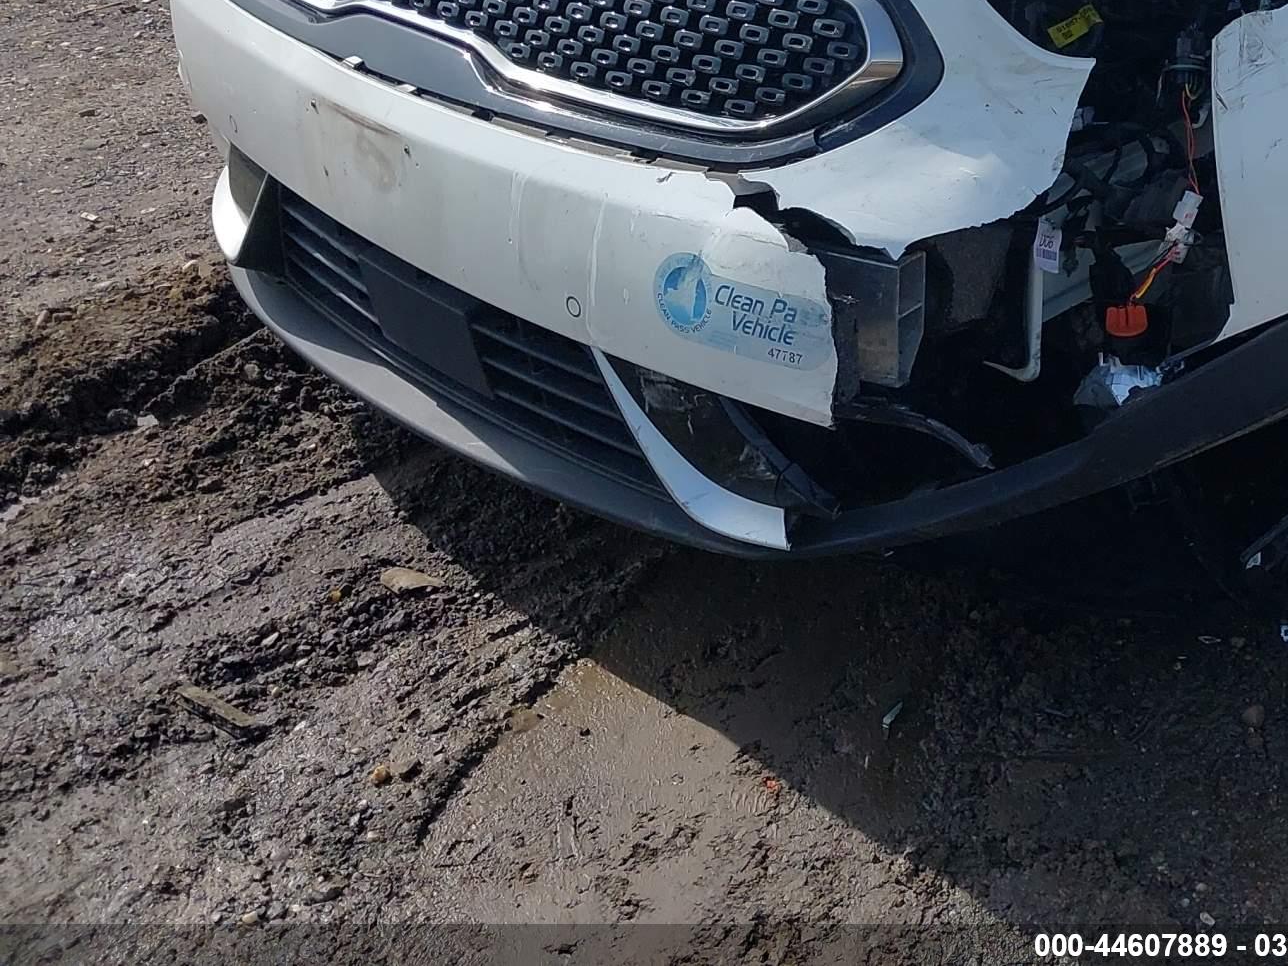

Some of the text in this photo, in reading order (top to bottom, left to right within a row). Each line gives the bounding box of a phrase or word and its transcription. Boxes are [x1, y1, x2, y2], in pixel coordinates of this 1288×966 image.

[657, 292, 713, 334] CLEAN PASS VEHICLE
[714, 284, 765, 317] Clean
[732, 310, 795, 346] Vehicle
